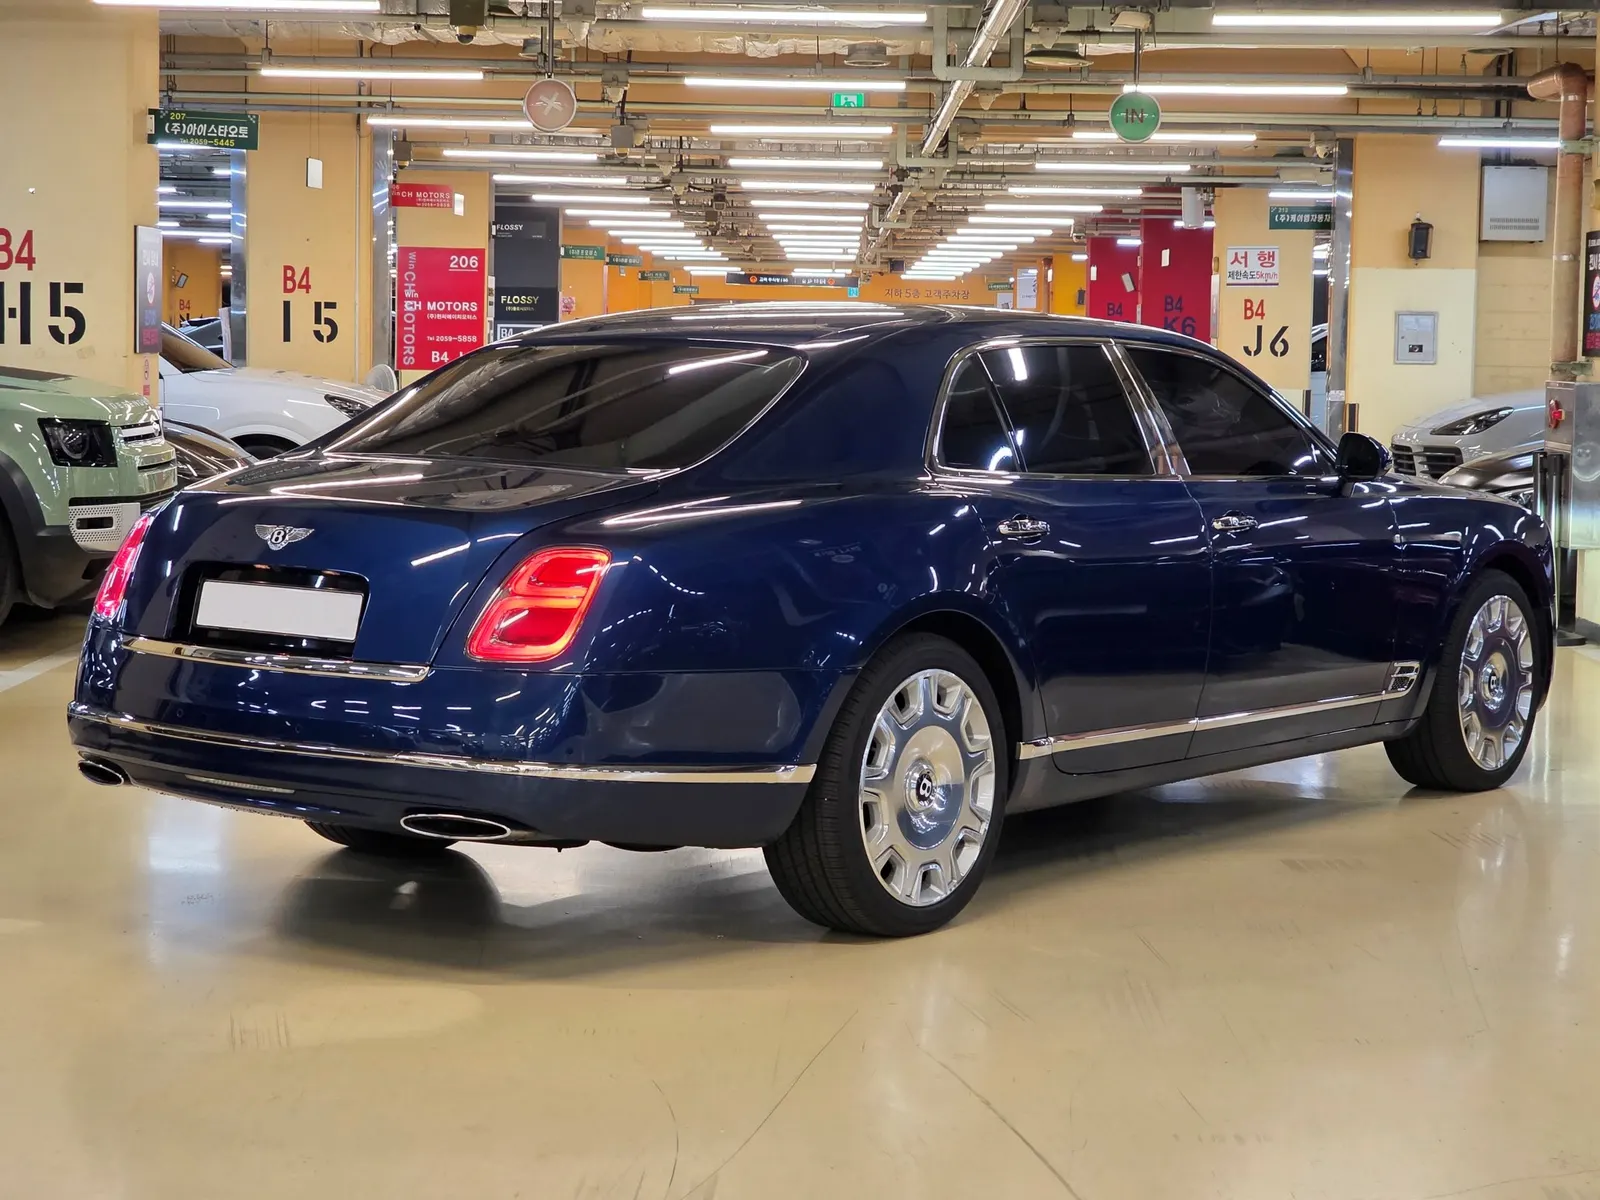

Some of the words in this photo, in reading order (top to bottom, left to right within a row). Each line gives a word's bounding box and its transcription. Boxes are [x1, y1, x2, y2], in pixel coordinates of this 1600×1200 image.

[170, 112, 186, 120] 207
[1125, 108, 1144, 123] IN
[165, 122, 249, 138] (주)아이스타오토
[449, 255, 479, 268] 206
[283, 265, 311, 293] B4
[179, 299, 191, 311] B4
[427, 301, 478, 311] MOTORS
[501, 295, 539, 305] FLOSSY
[1164, 294, 1184, 312] B4
[1107, 303, 1123, 317] B4
[1244, 299, 1265, 320] B4
[1243, 325, 1290, 357] J6
[431, 351, 449, 362] B4
